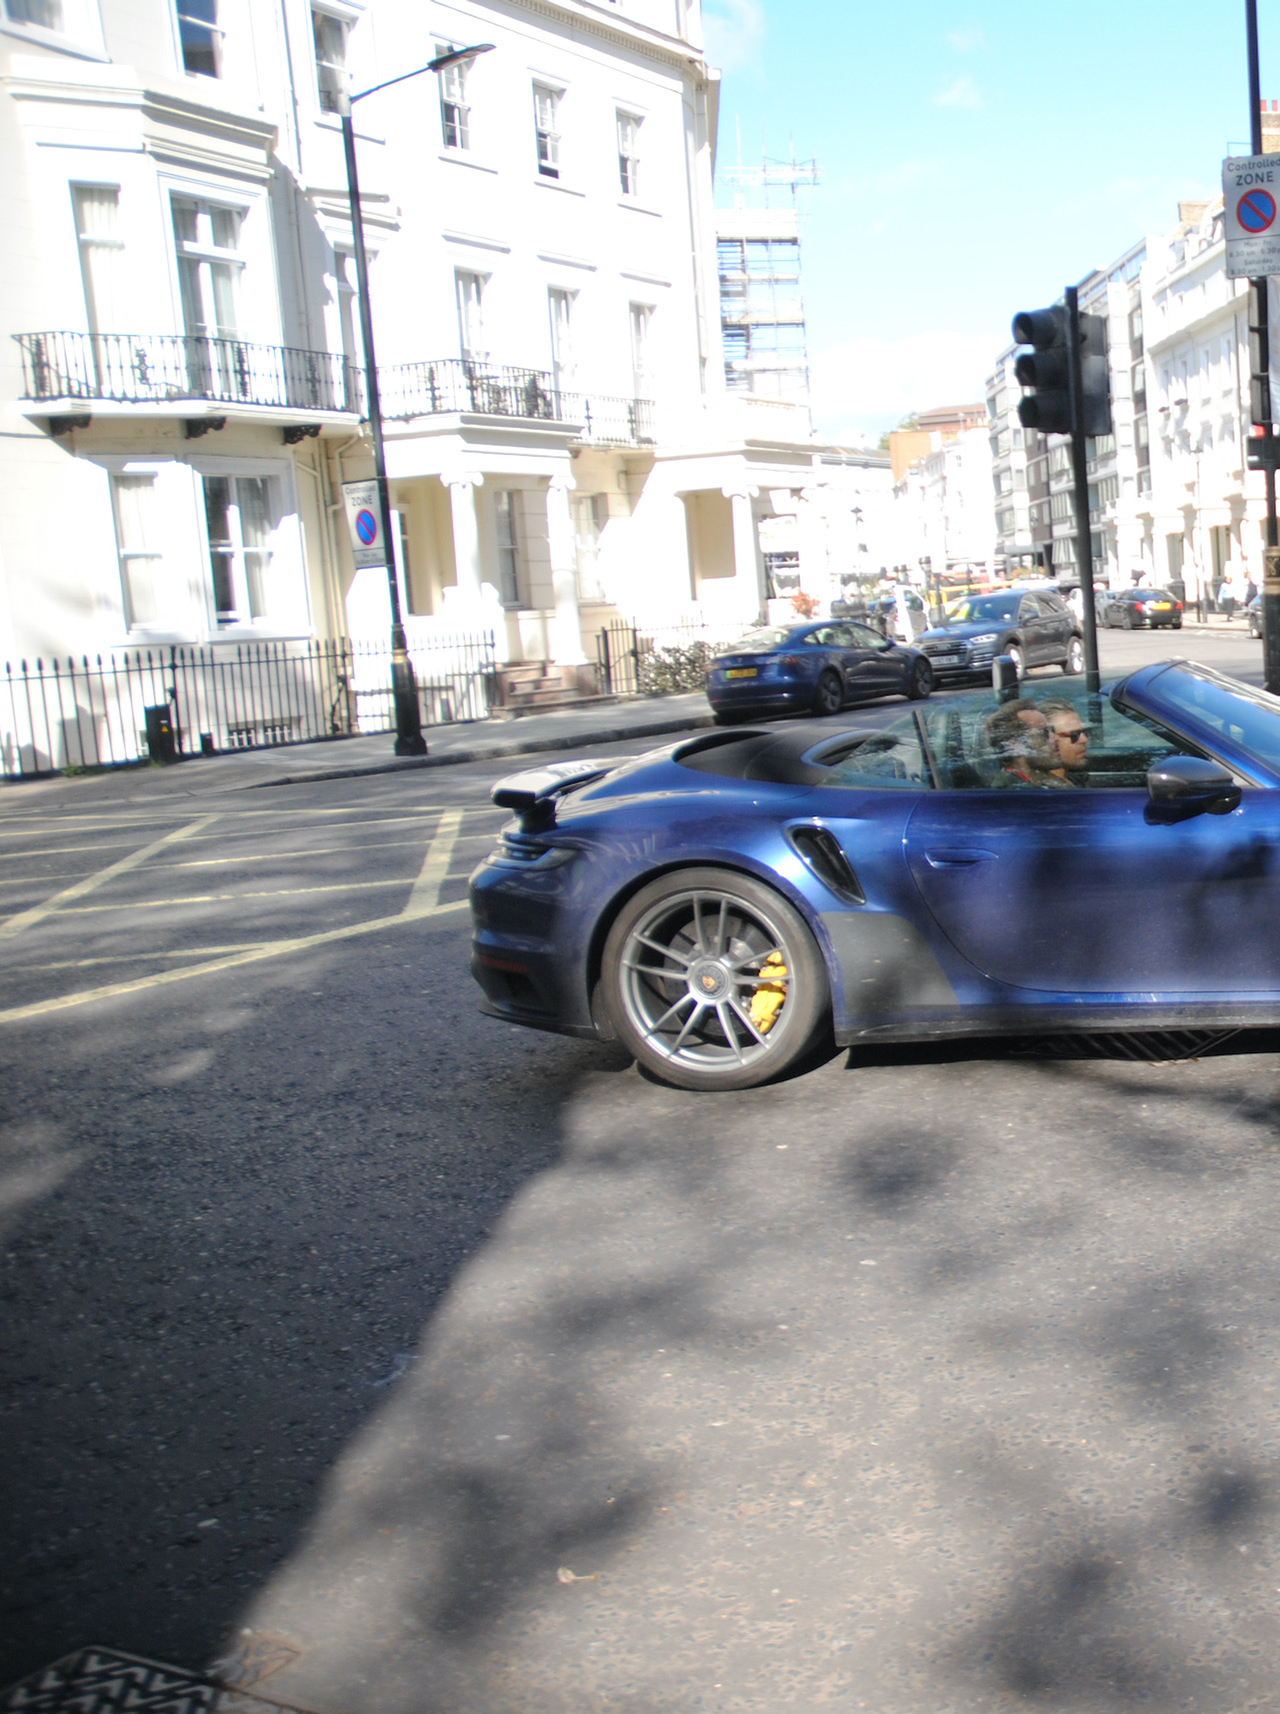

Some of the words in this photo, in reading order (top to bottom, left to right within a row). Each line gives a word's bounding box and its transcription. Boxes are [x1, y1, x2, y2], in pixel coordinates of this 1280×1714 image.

[1235, 171, 1275, 186] ZONE
[1244, 257, 1273, 266] Saturday
[351, 494, 373, 507] ZONE
